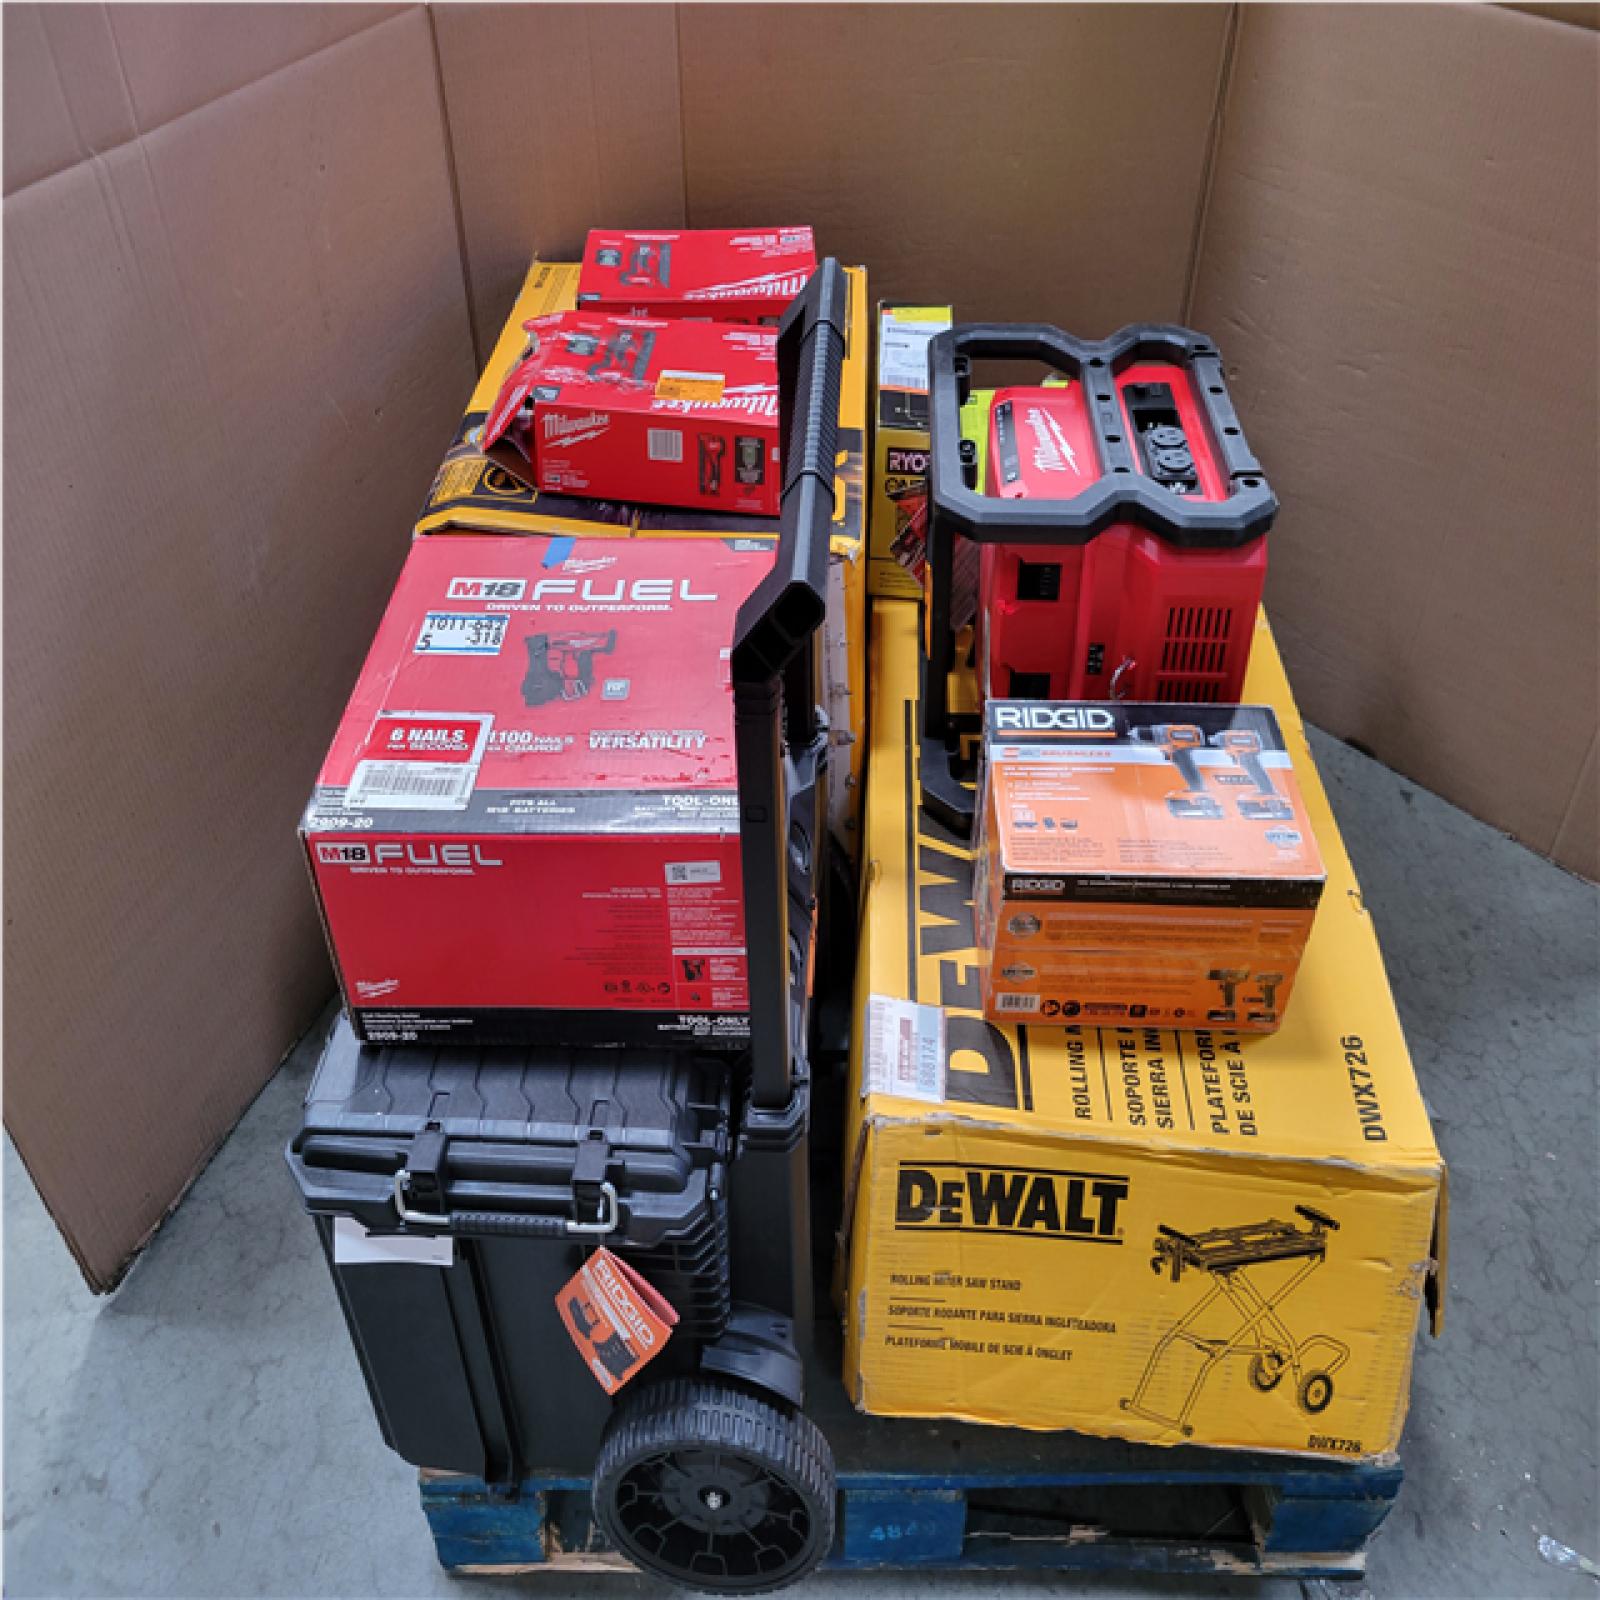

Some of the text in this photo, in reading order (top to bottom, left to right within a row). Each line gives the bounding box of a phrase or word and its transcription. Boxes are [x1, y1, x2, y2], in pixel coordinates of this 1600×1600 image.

[889, 451, 930, 472] RYO
[448, 578, 718, 601] M18 FUEL
[994, 706, 1116, 729] RIDGID
[407, 728, 466, 741] NAILS
[589, 736, 706, 750] VERSATILITY
[662, 794, 738, 806] TOOL-ONL
[319, 843, 503, 866] M18 FUEL
[1066, 1040, 1093, 1120] ROLLING
[1117, 1039, 1146, 1127] SOPORTE
[1226, 1058, 1251, 1104] SCIE
[1340, 1034, 1388, 1141] DWX726
[1147, 1057, 1175, 1130] SIERRA
[1237, 1109, 1259, 1136] DE
[889, 1274, 931, 1286] ROLLING
[964, 1276, 986, 1289] SAW
[989, 1278, 1021, 1292] STAND
[592, 1258, 655, 1348] RIDGID
[888, 1304, 931, 1318] SOPORTE
[934, 1307, 977, 1321] RODANTE
[979, 1309, 1006, 1323] PARA
[1007, 1311, 1044, 1326] SIERRA
